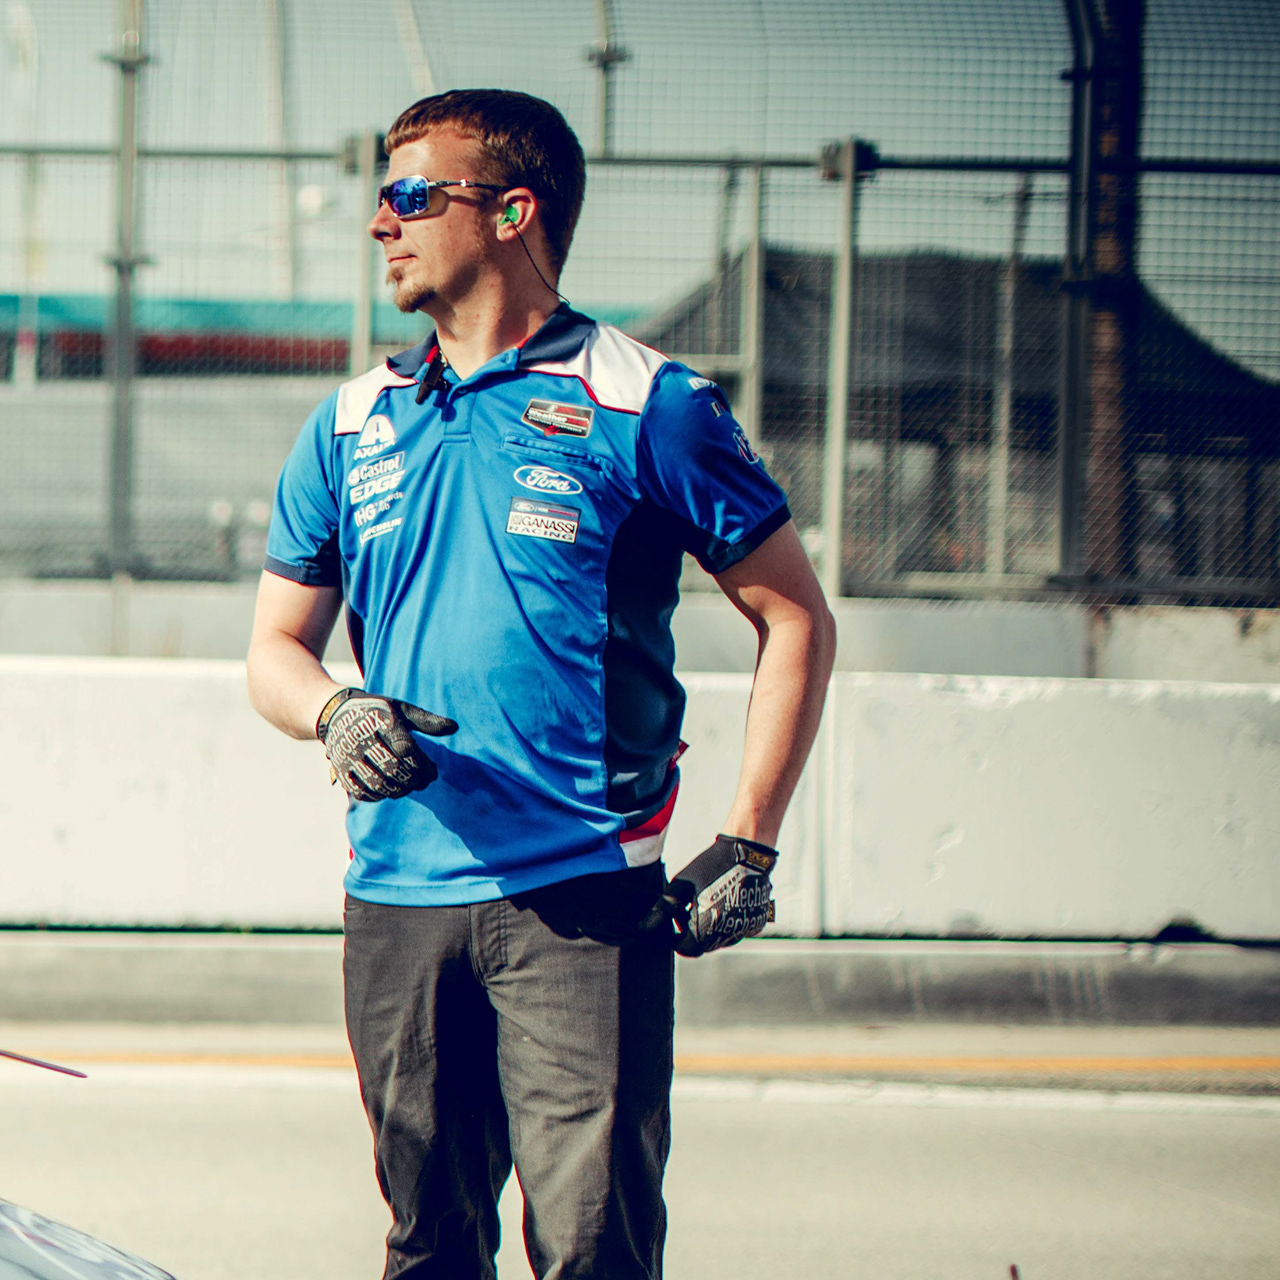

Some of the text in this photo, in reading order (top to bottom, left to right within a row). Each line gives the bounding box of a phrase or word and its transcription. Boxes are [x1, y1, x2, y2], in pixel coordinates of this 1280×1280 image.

[349, 469, 406, 505] EDGE
[526, 469, 571, 491] Ford
[509, 525, 573, 540] RACING
[522, 515, 575, 534] GANASSI
